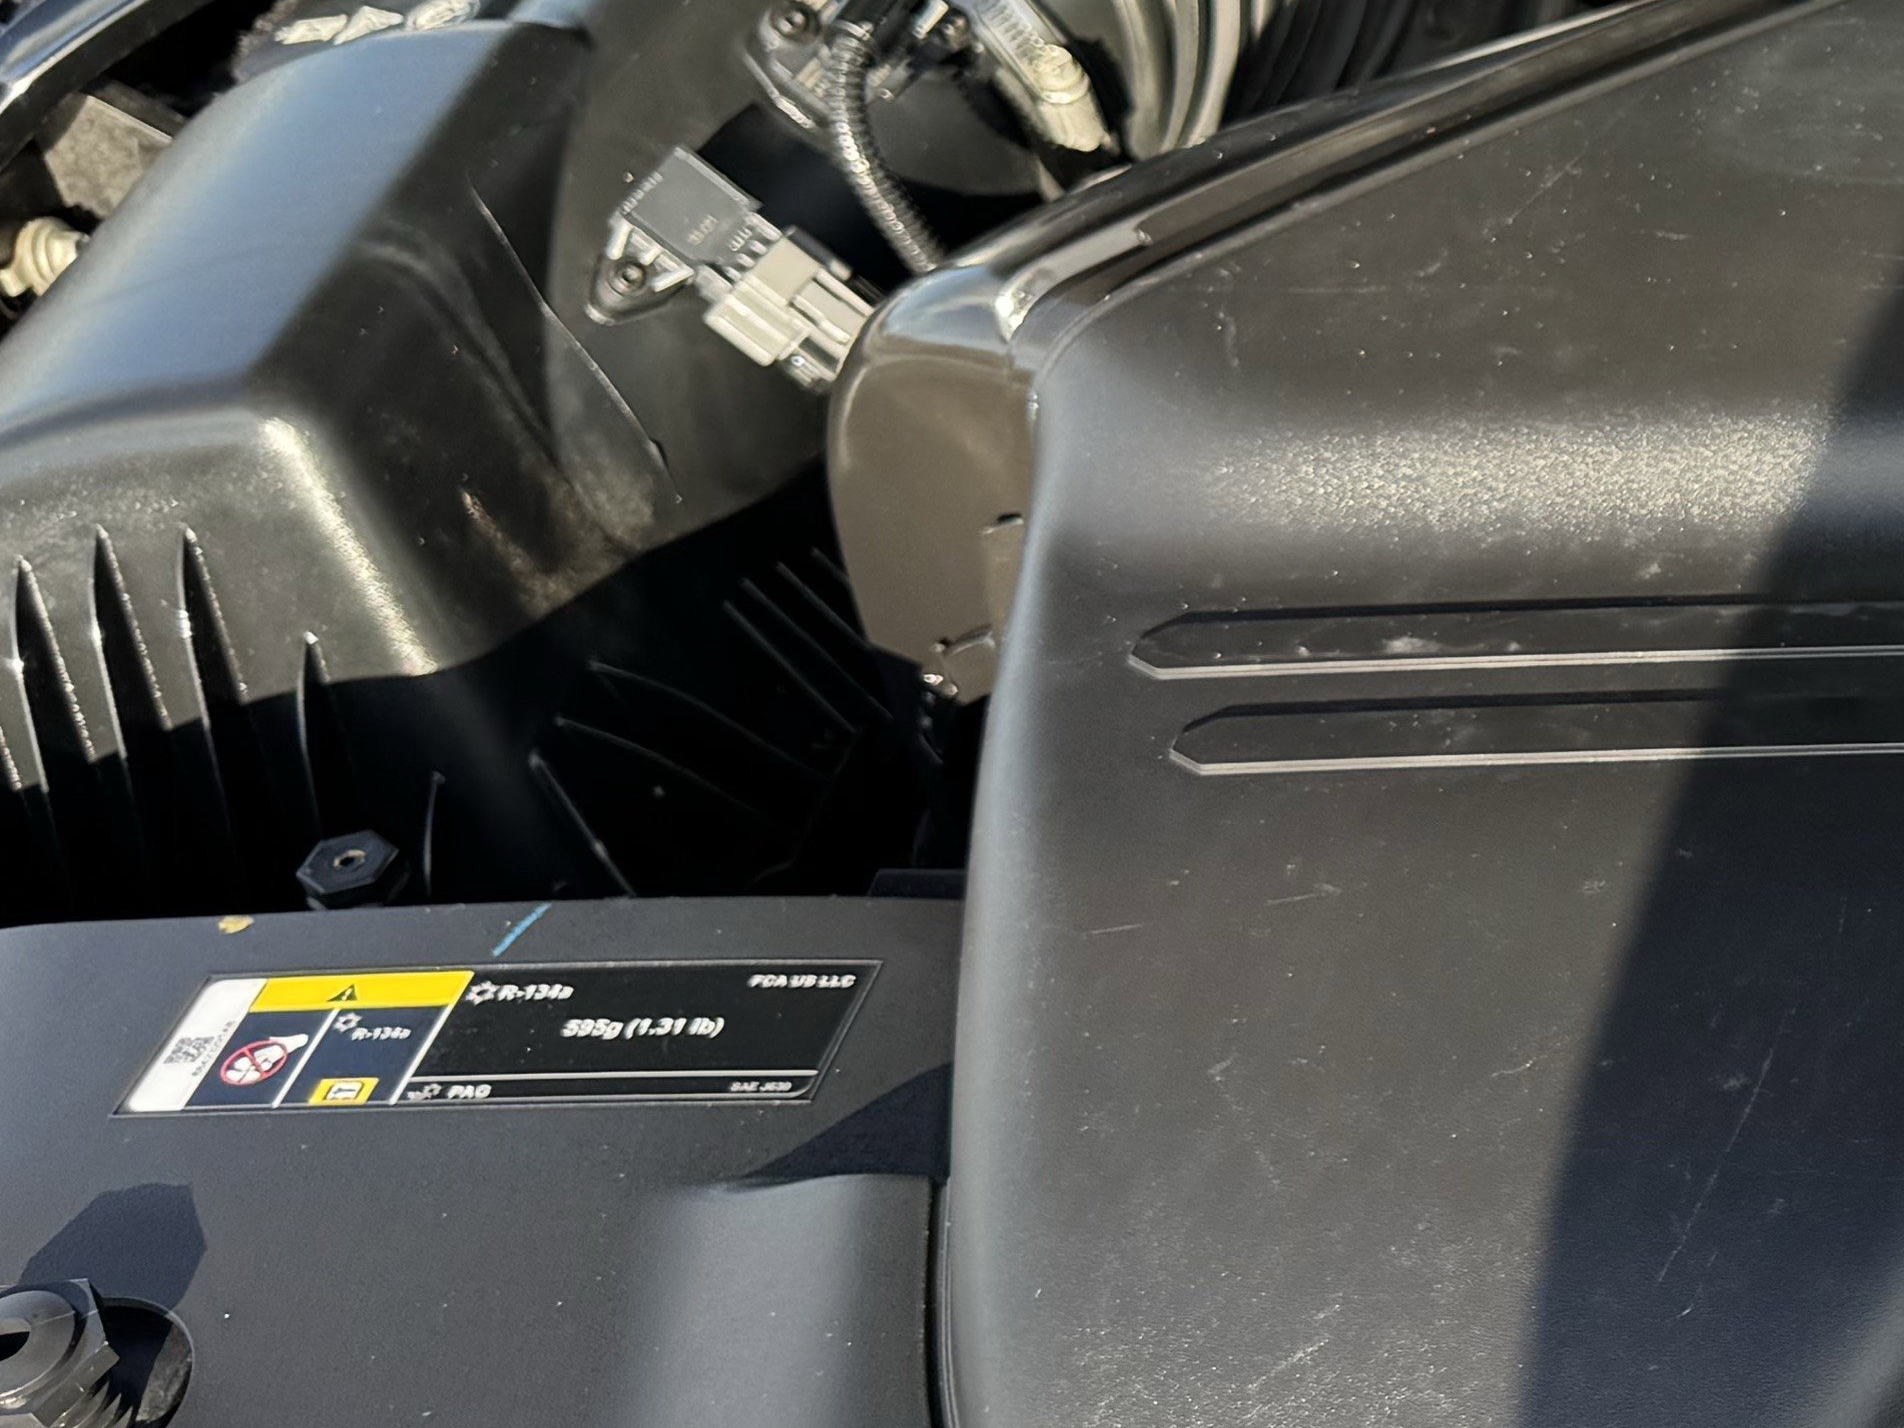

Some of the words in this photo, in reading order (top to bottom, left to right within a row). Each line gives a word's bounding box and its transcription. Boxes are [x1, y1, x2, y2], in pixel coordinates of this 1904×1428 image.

[818, 973, 857, 988] LLC
[498, 983, 575, 1001] R-134a
[624, 1017, 687, 1040] (1.31
[688, 1016, 725, 1039] lb)
